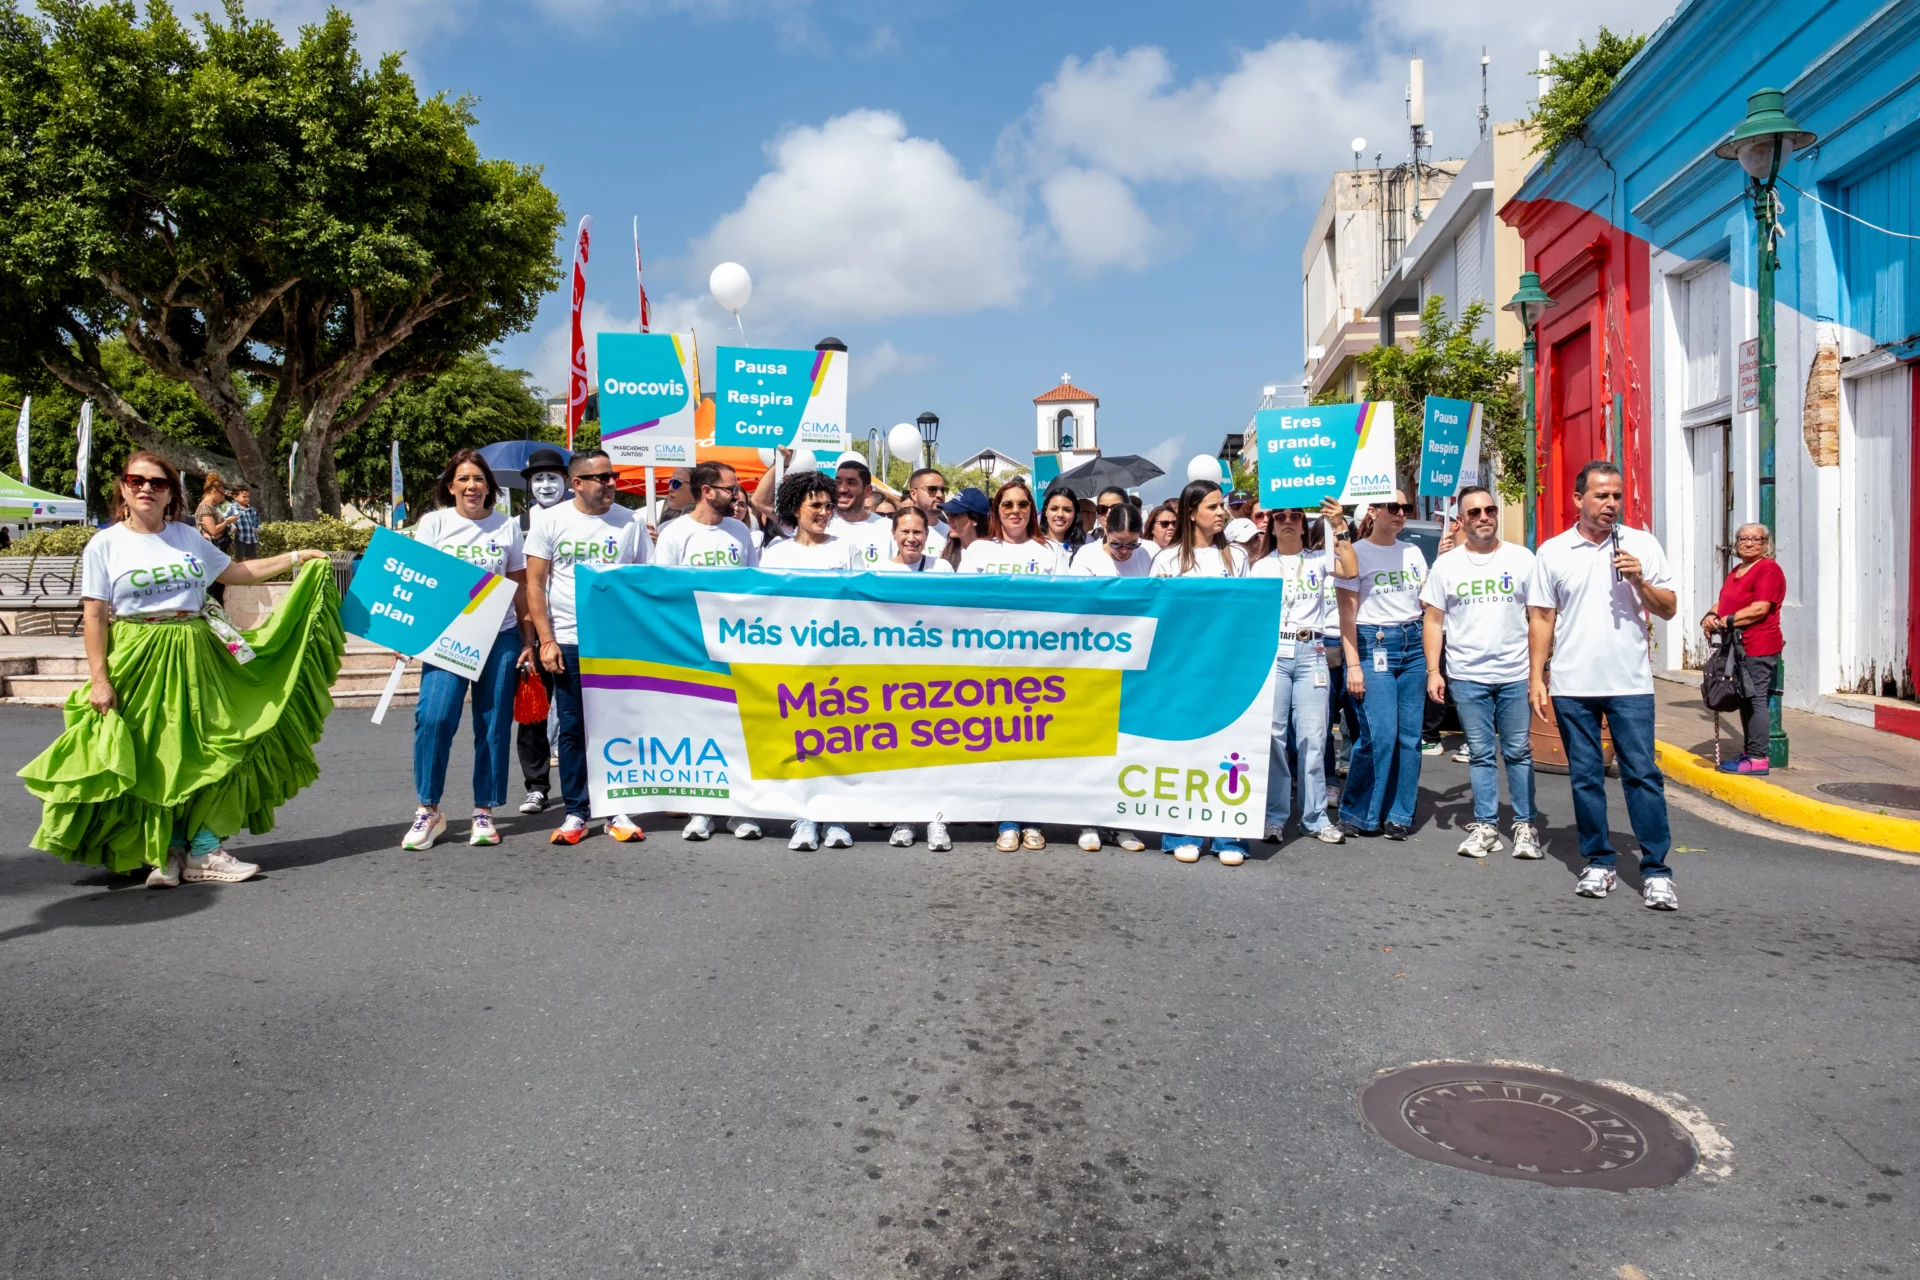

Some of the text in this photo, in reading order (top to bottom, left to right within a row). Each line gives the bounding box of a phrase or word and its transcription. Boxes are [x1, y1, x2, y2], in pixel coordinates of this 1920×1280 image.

[1747, 344, 1755, 358] NO
[735, 359, 788, 375] Pausa
[604, 378, 685, 396] Orocovis
[1742, 376, 1752, 386] ZONA
[727, 390, 793, 407] Respira
[1743, 388, 1757, 399] CARGA
[1280, 416, 1322, 430] Eres
[1433, 409, 1458, 424] Pausa
[735, 421, 784, 436] Corre
[801, 422, 840, 433] CIMA
[655, 445, 685, 453] CIMA
[1267, 434, 1337, 453] grande,
[1428, 439, 1459, 457] Respira
[1293, 454, 1312, 467] tú
[1270, 474, 1337, 491] puedes
[1350, 475, 1391, 486] CIMA
[1431, 470, 1453, 487] Llega
[1461, 471, 1476, 480] CIMA
[558, 541, 619, 559] CERO
[690, 550, 741, 566] CERO
[130, 560, 204, 588] CERO
[383, 557, 439, 589] Sigue
[985, 563, 1040, 575] CERO
[1374, 569, 1422, 586] CERO
[133, 580, 206, 598] SUICIDIO
[392, 584, 414, 602] tu
[1456, 578, 1515, 597] CERO
[370, 601, 415, 626] plan
[718, 617, 1132, 653] Más vida, más momentos
[1280, 631, 1296, 641] TAFF
[436, 647, 479, 667] MENONITA
[439, 637, 481, 661] CIMA
[777, 675, 1066, 719] Más razones
[794, 705, 1053, 762] para seguir
[603, 737, 728, 767] CIMA
[606, 769, 729, 784] MENONITA
[1118, 762, 1250, 806] CERO
[612, 787, 724, 797] SALUD MENTAL
[1116, 801, 1248, 825] SUICIDIO
